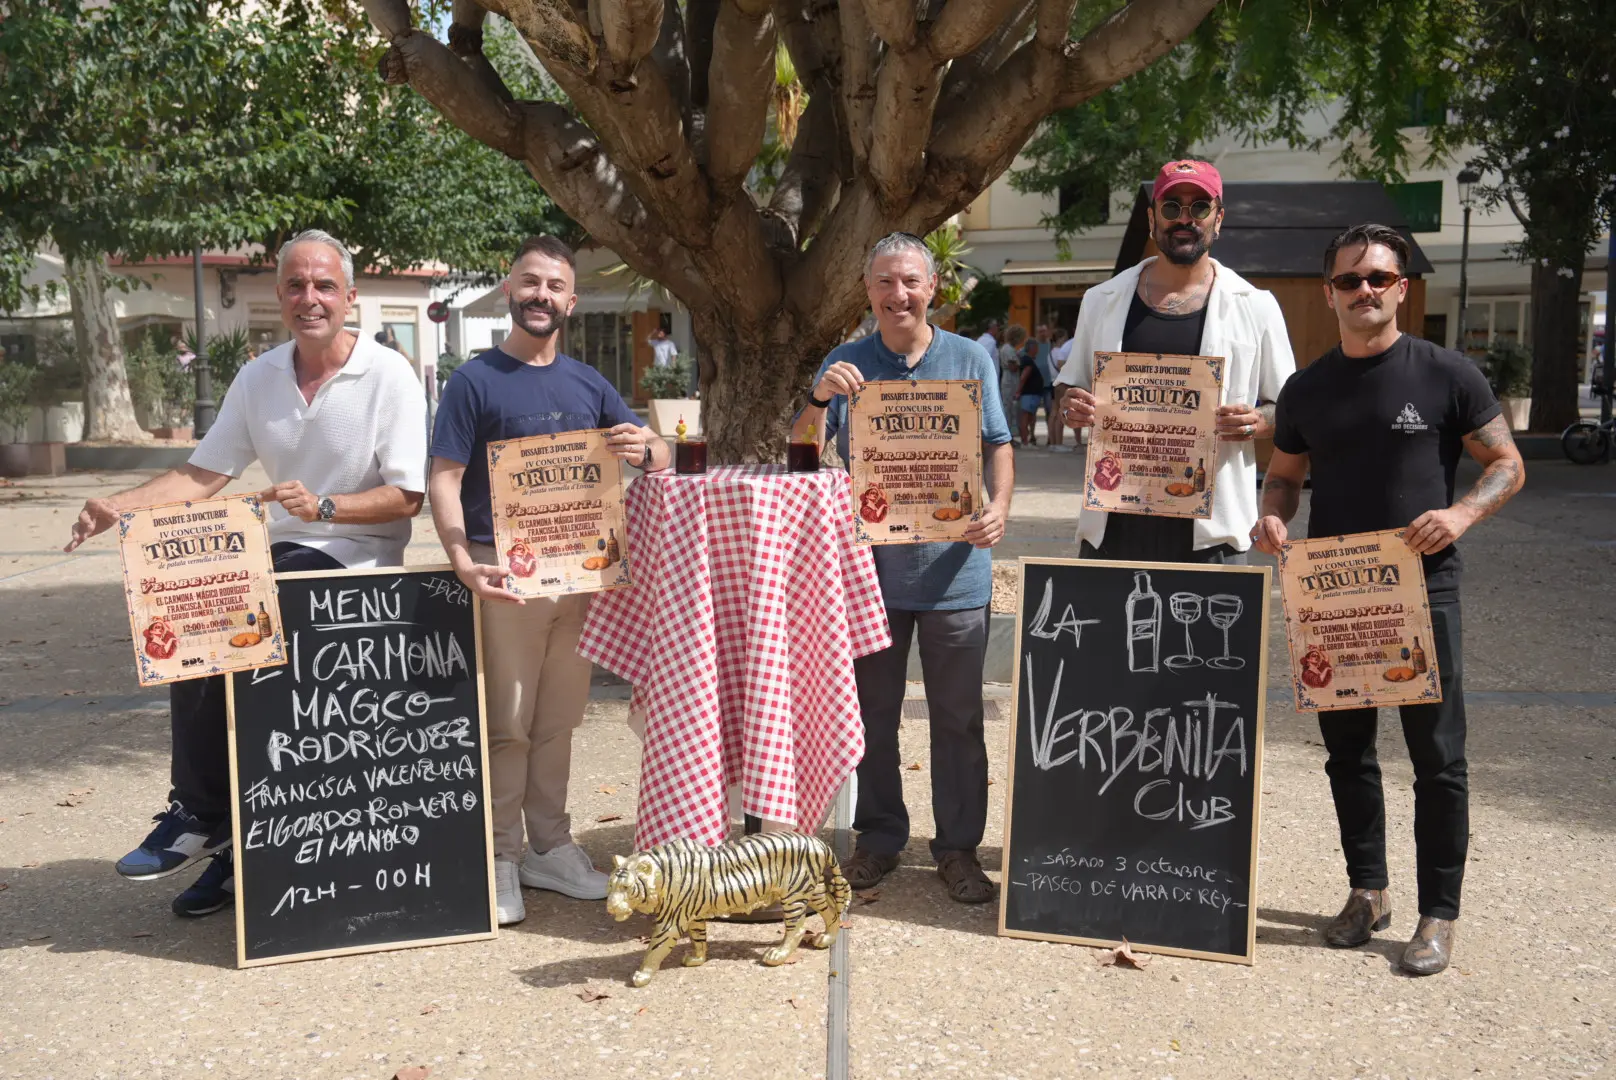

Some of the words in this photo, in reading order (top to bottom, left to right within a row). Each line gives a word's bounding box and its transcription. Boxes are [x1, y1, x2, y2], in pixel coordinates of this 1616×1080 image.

[1126, 365, 1153, 373] DISSABTE
[1138, 378, 1174, 386] CONCURS
[916, 392, 948, 400] D'OCTUBRE
[1114, 387, 1197, 407] TRUITA
[870, 415, 957, 432] TRUITA
[521, 447, 549, 457] DISSABTE
[863, 451, 958, 461] VERBENITA
[1120, 445, 1150, 453] FRANCISCA
[1152, 447, 1187, 456] VALENZUELA
[536, 457, 572, 466] CONCURS
[512, 465, 599, 487] TRUITA
[153, 515, 185, 527] DISSABTE
[192, 509, 229, 522] D'OCTUBRE
[171, 526, 212, 537] CONCURS
[528, 526, 559, 536] FRANCISCA
[560, 523, 596, 533] VALENZUELA
[144, 533, 243, 559] TRUITA
[1308, 550, 1338, 560] DISSABTE
[1345, 544, 1381, 555] D'OCTUBRE
[1325, 559, 1365, 570] CONCURS
[141, 570, 249, 594] VERBENITA
[1301, 567, 1397, 590] TRUITA
[167, 602, 202, 613] FRANCISCA
[204, 596, 244, 608] VALENZUELA
[309, 578, 402, 622] MENÚ
[1028, 576, 1101, 648] LA
[1299, 603, 1404, 623] VERBENITA
[1323, 633, 1357, 643] FRANCISCA
[1358, 629, 1399, 640] VALENZUELA
[313, 631, 470, 681] CARMONA
[273, 808, 361, 847] GORDO
[365, 790, 477, 825] ROMERO
[329, 824, 420, 857] MANOLO
[1042, 848, 1104, 868] SÁBADO
[1115, 856, 1127, 871] 3
[271, 881, 336, 916] 12H
[1091, 880, 1116, 896] DE
[1122, 882, 1168, 901] VARA
[1173, 887, 1192, 902] DE
